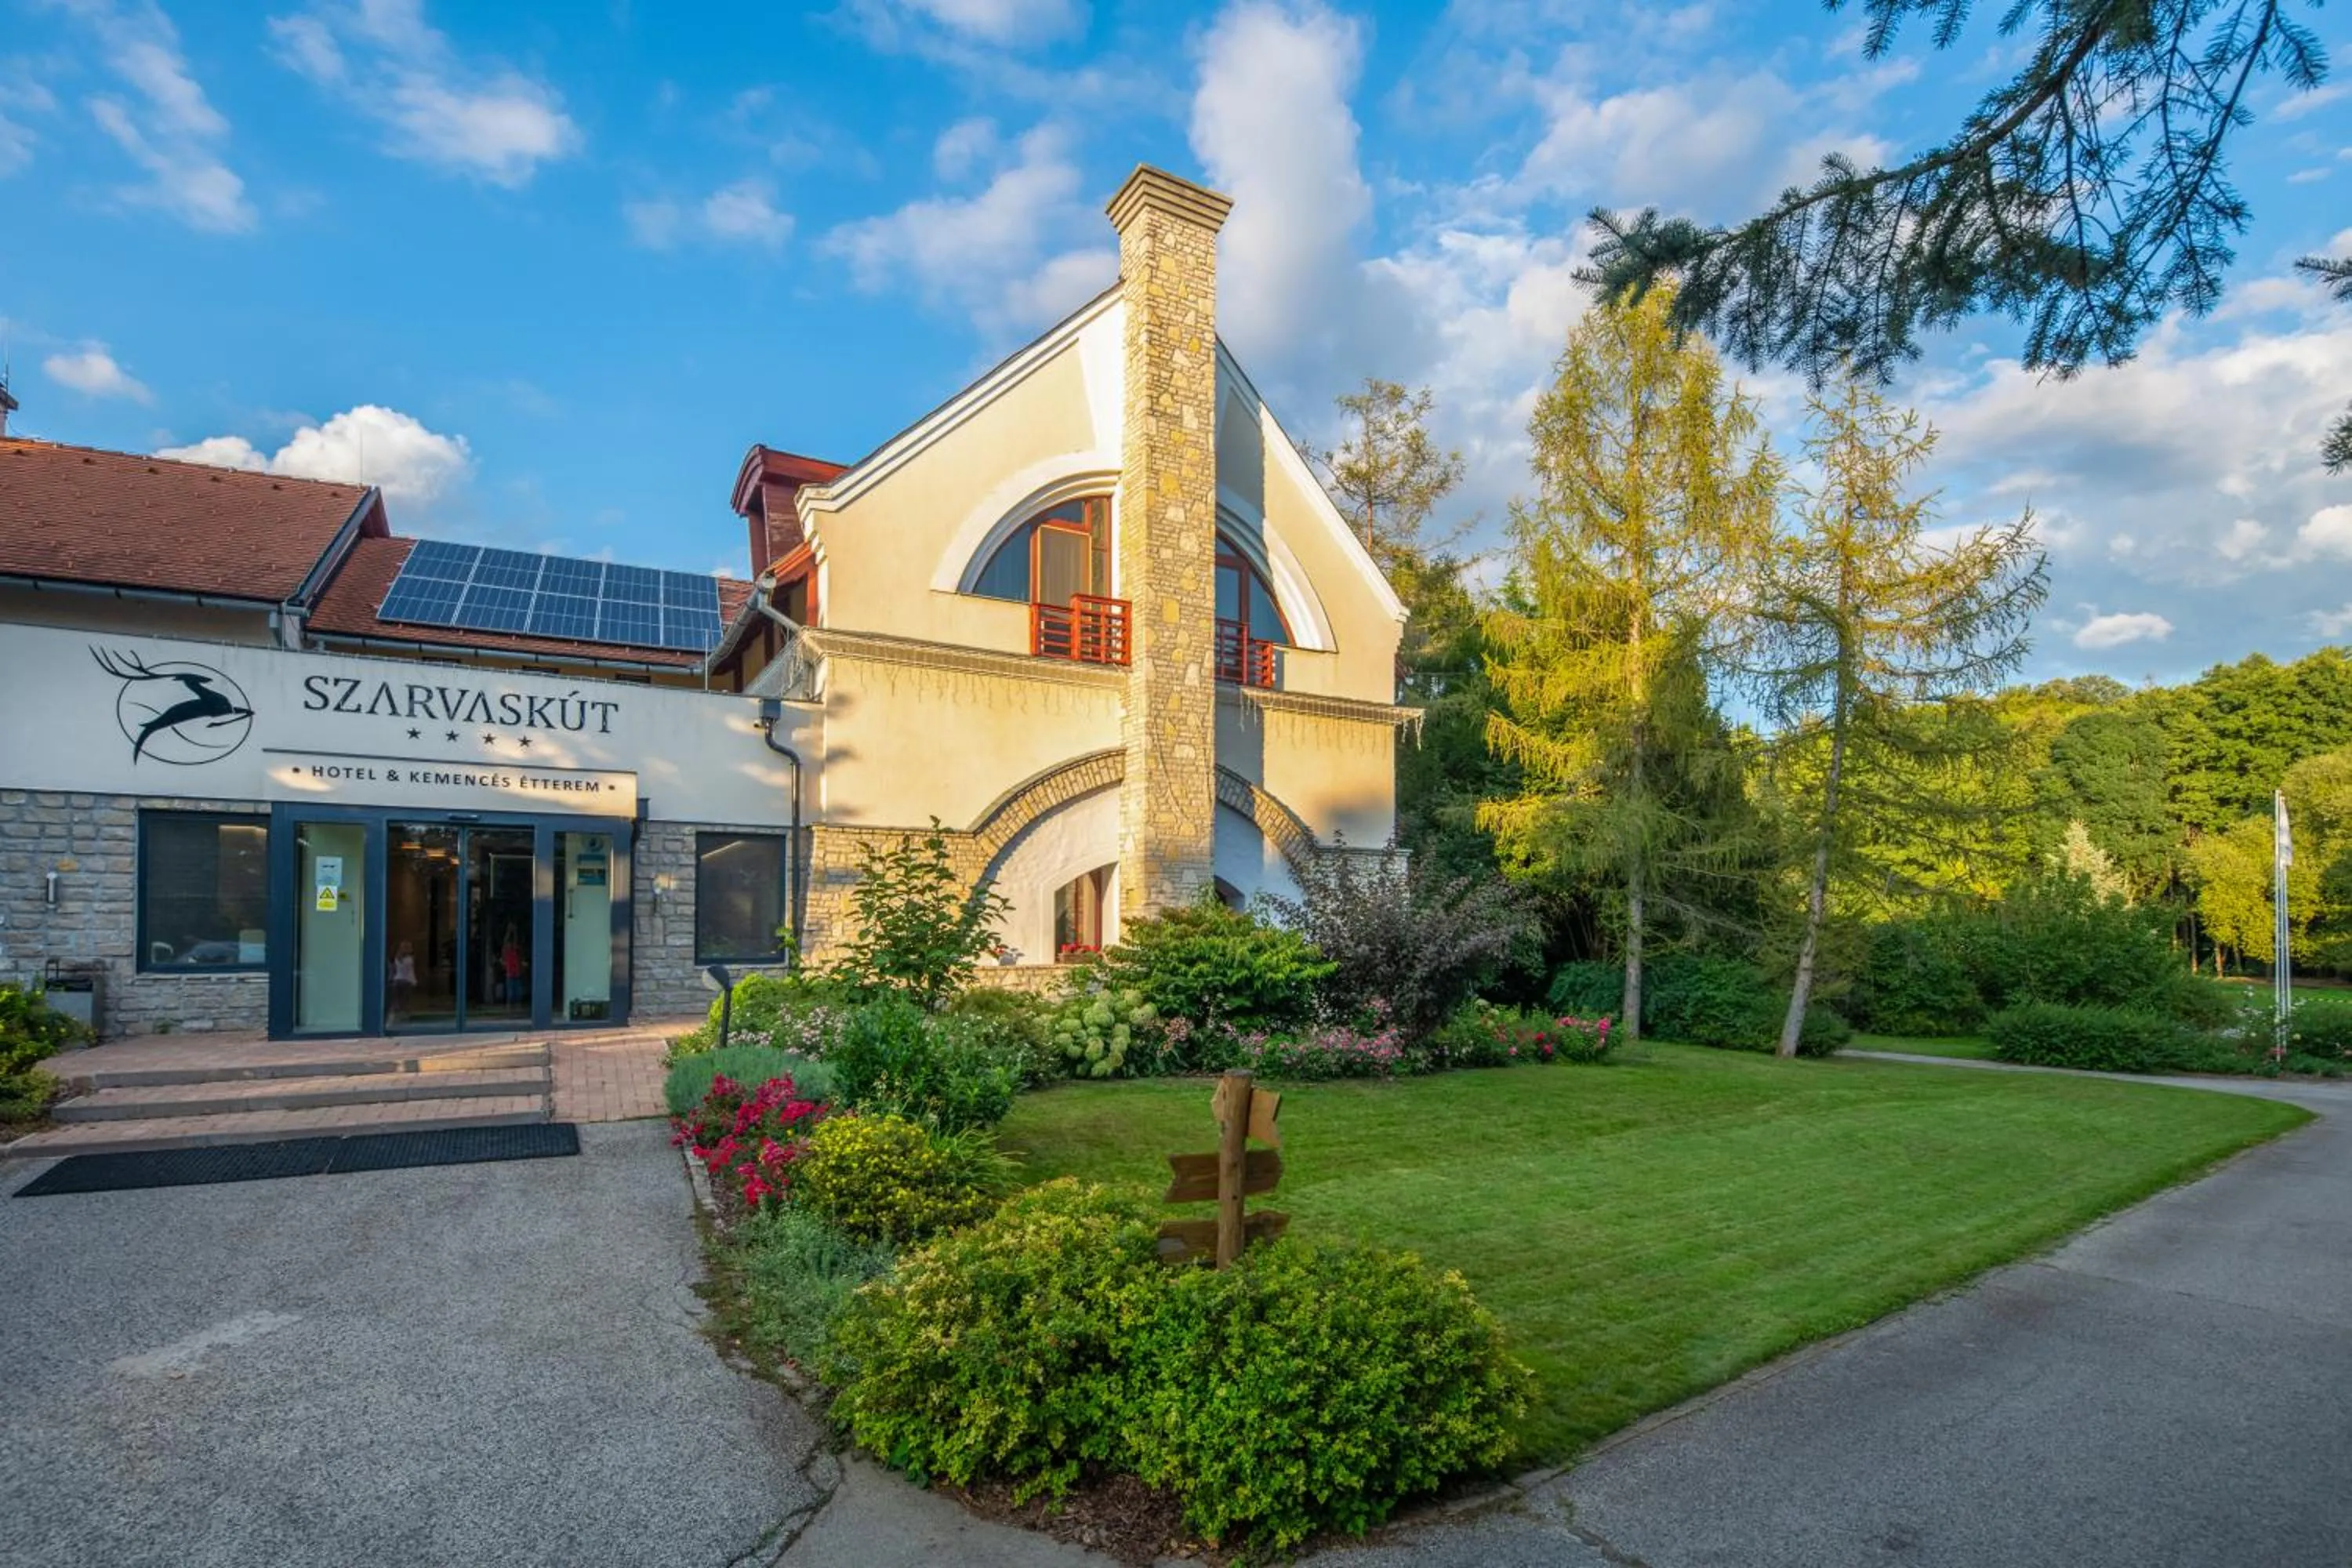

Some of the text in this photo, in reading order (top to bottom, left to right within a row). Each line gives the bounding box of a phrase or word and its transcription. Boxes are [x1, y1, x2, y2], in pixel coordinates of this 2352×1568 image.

[303, 675, 619, 734] SZARVASKÚT
[312, 765, 601, 792] HOTEL & KEMENCÉS ÉTTEREM
